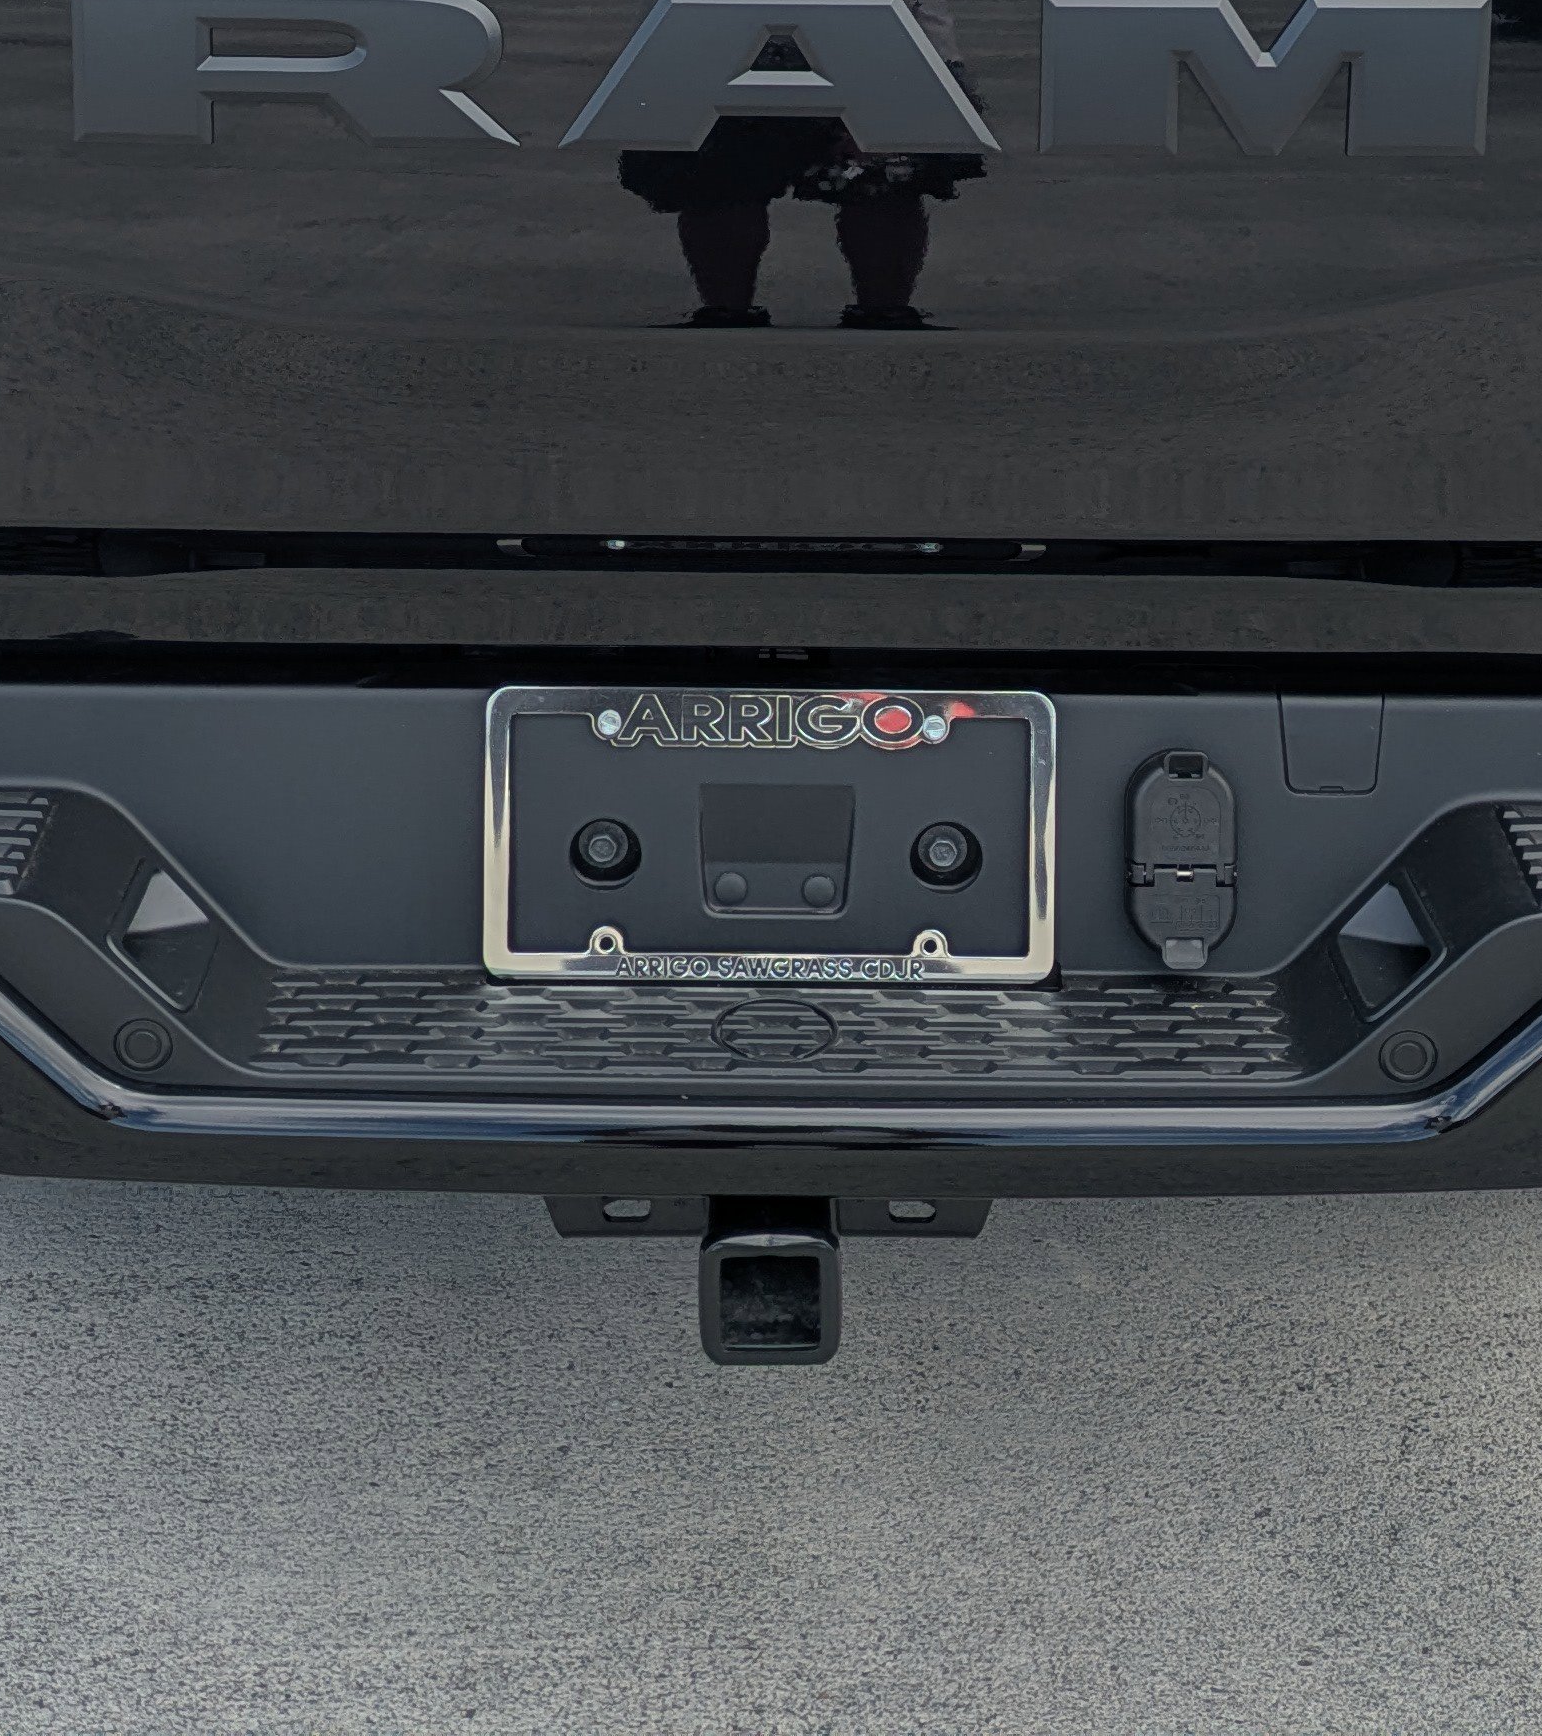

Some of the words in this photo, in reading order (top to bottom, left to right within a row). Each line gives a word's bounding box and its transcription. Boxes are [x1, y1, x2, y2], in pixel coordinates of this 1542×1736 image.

[616, 692, 926, 748] ARRIGO
[614, 956, 711, 979] ARRIGO
[716, 956, 854, 980] SAWGRASS
[860, 958, 926, 981] CDJR
